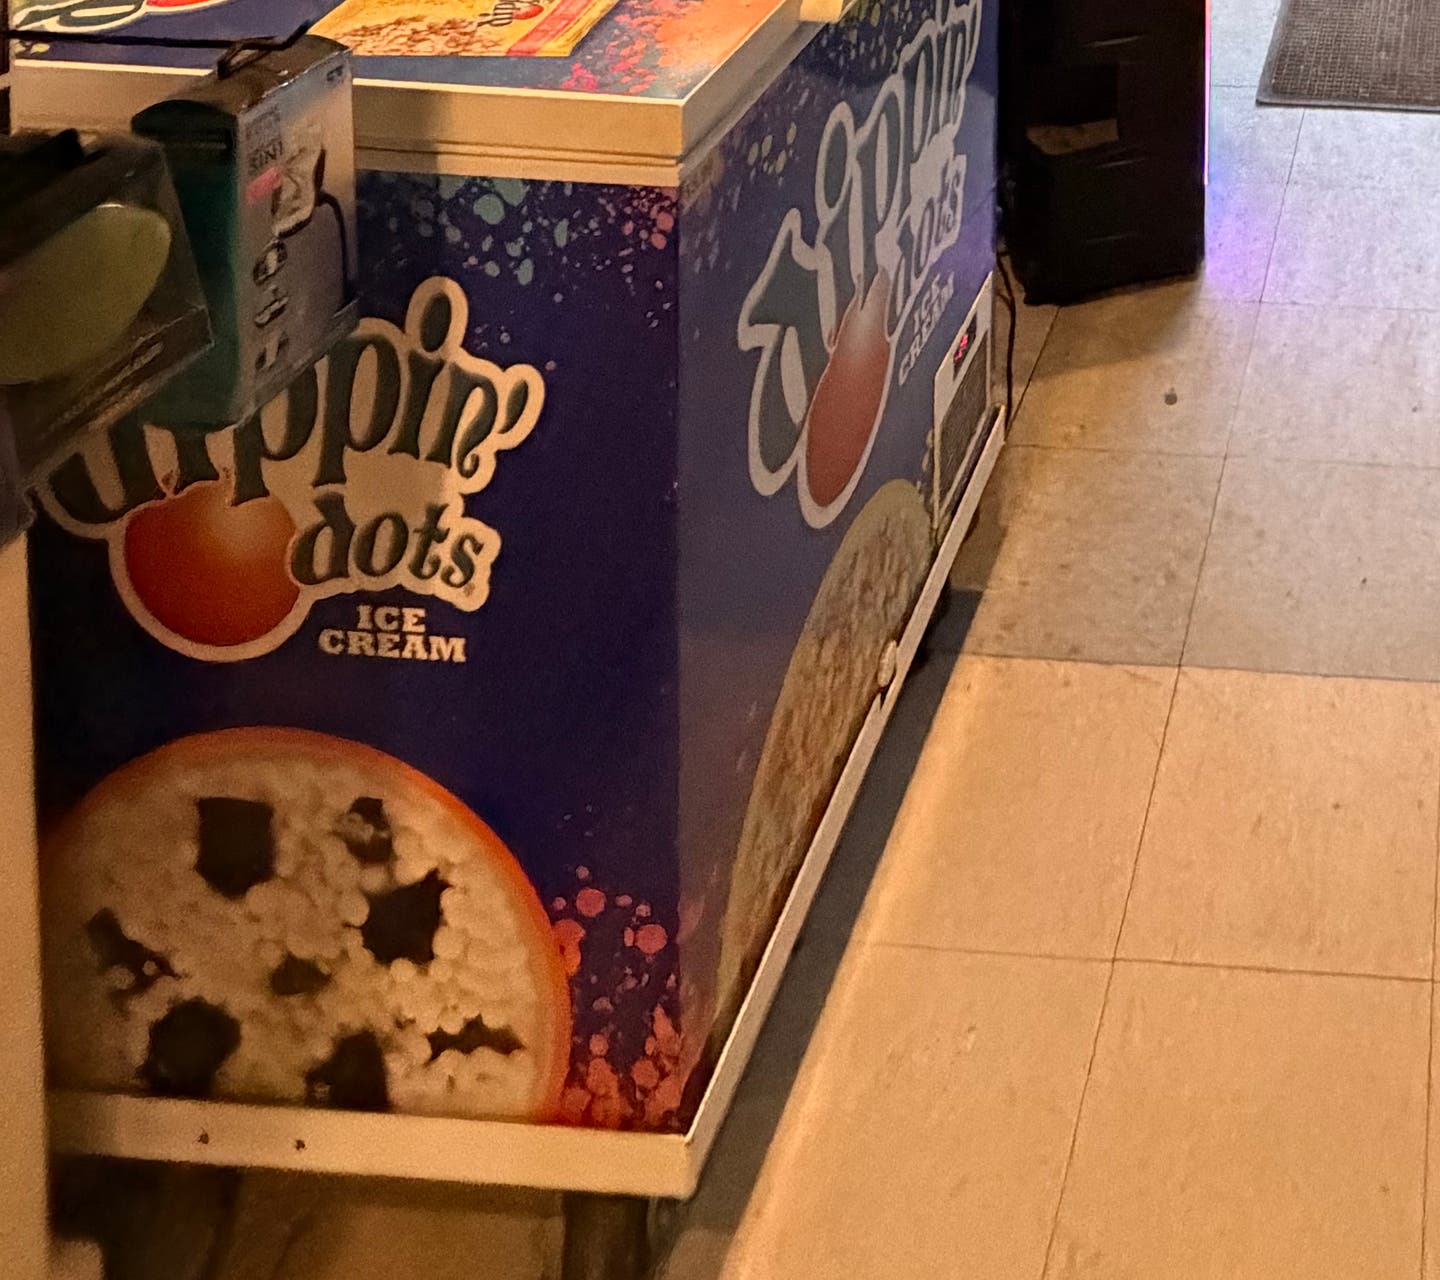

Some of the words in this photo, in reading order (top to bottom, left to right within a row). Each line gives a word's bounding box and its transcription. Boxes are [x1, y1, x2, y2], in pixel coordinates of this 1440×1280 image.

[291, 488, 485, 589] dots
[357, 605, 426, 634] ICE
[318, 630, 467, 663] CREAM
